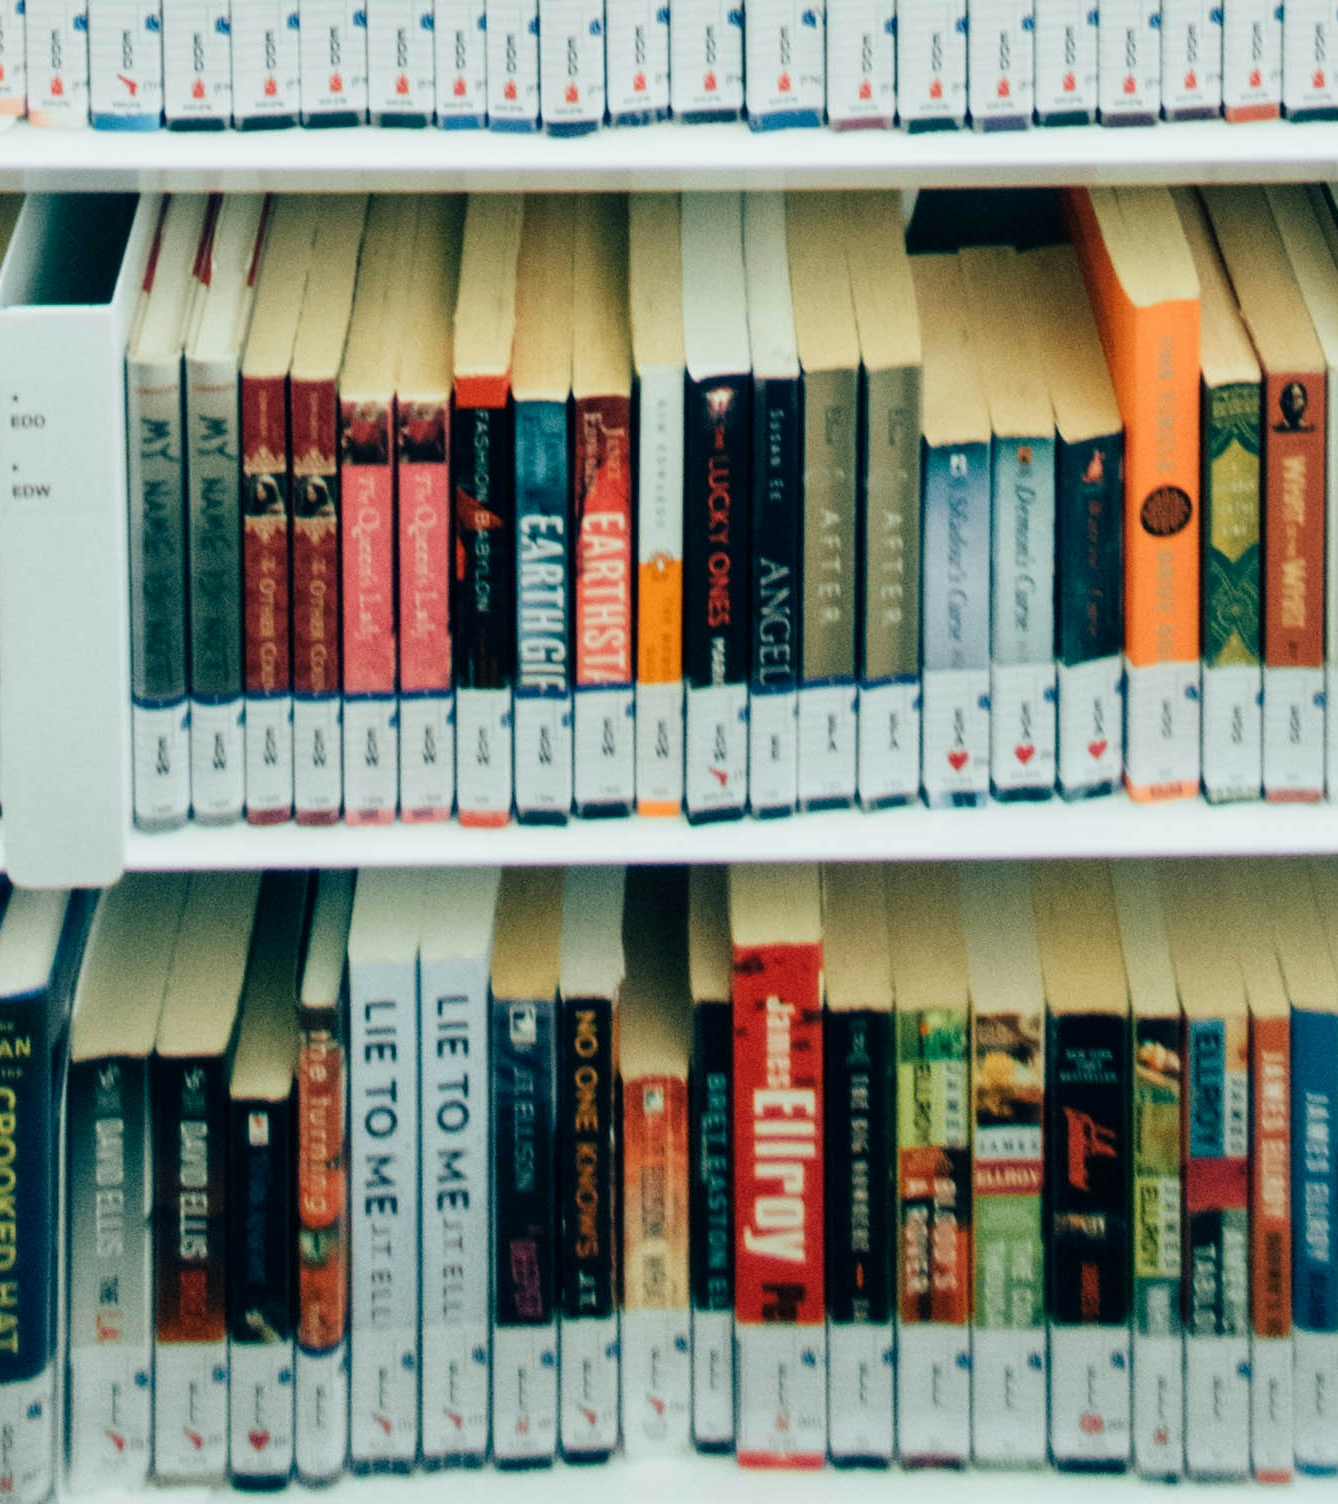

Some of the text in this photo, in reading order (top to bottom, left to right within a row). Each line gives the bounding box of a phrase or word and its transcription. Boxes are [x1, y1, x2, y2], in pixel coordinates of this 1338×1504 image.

[707, 551, 730, 628] ONES
[364, 1000, 399, 1216] LIE TO ME
